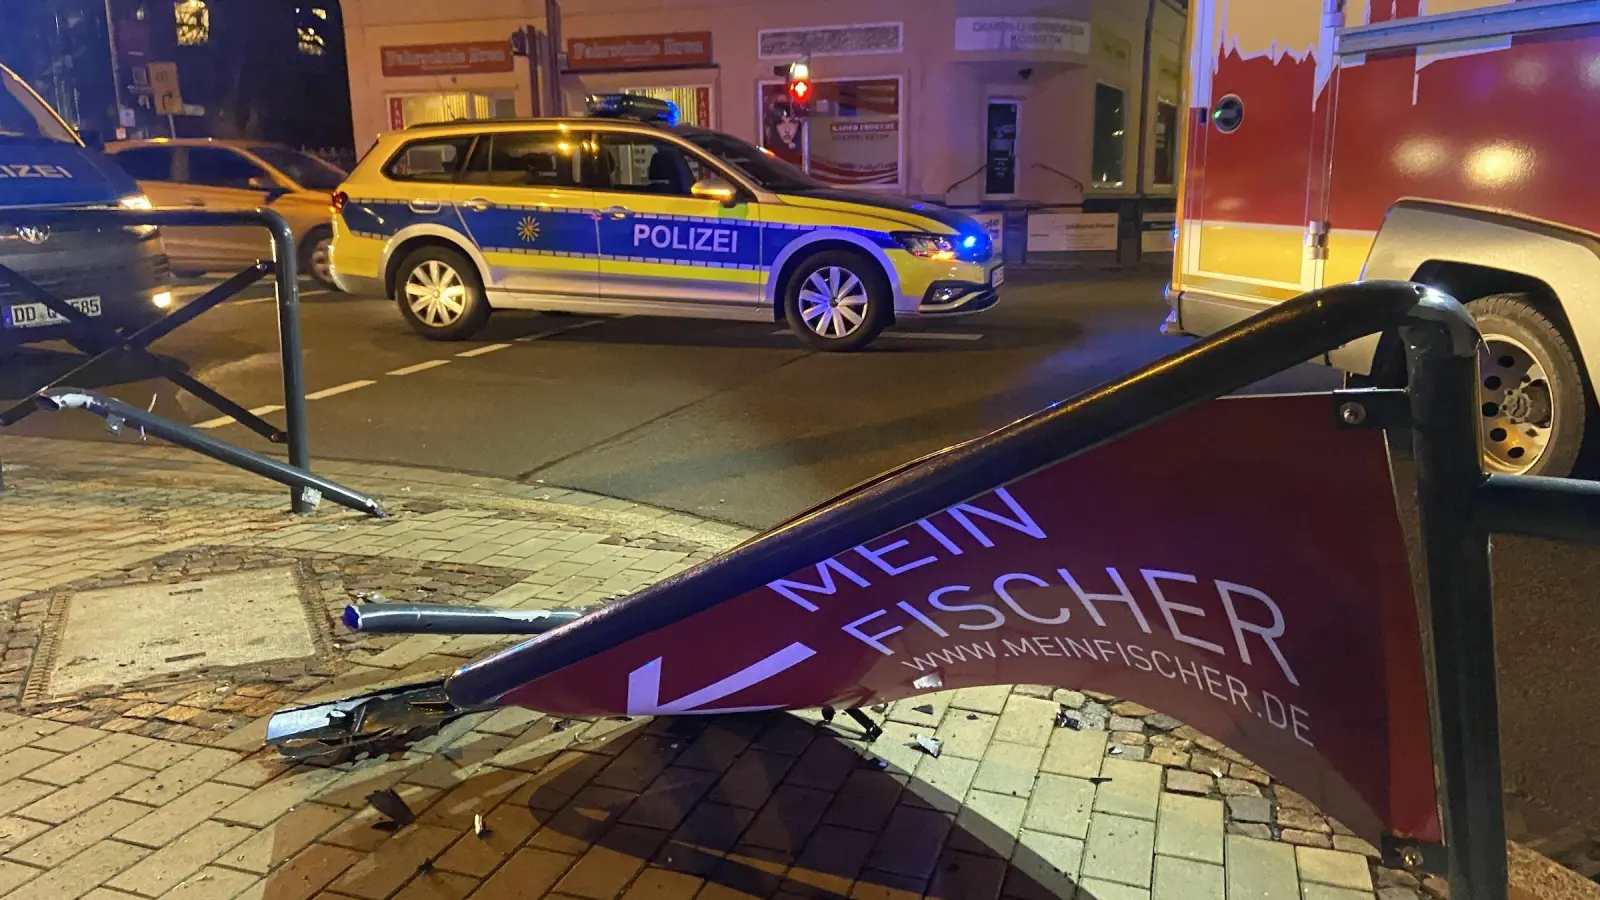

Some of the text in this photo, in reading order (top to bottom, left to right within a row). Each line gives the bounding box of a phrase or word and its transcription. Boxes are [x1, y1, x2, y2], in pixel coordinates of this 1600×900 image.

[0, 164, 73, 178] IZEI
[633, 223, 738, 253] POLIZEI
[13, 306, 37, 323] DD
[767, 487, 1047, 612] MEIN
[842, 566, 1300, 686] FISCHER
[902, 636, 1315, 747] WWW.MEINFISCHER.DE
